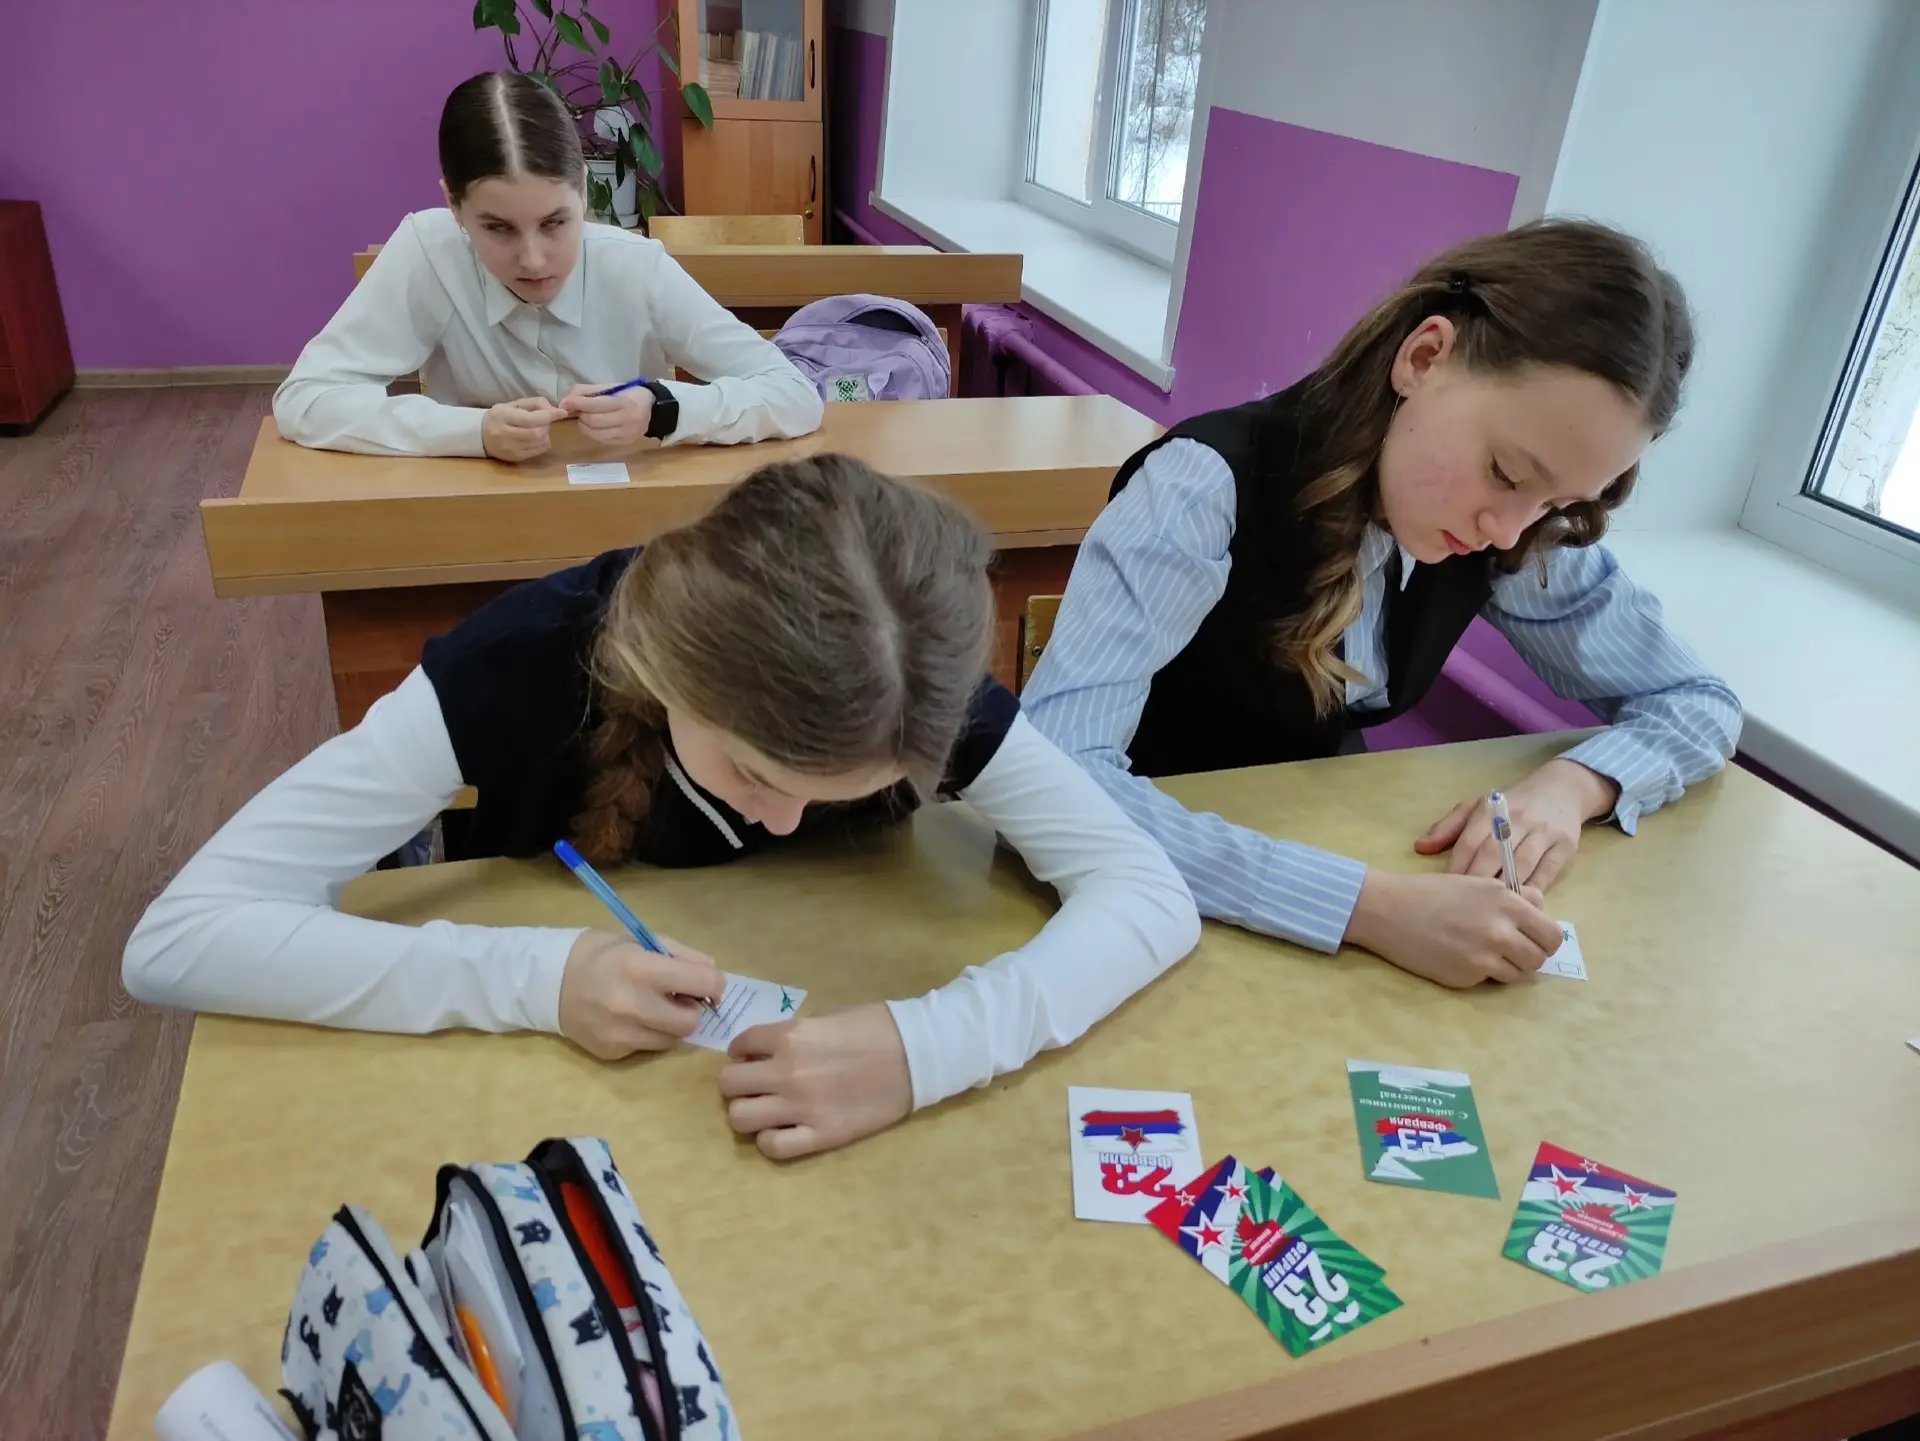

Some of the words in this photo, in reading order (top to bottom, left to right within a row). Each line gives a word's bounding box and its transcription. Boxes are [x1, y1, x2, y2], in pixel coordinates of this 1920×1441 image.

[1389, 1116, 1447, 1132] февраля
[1458, 1111, 1468, 1120] С
[1098, 1151, 1173, 1170] февраля
[1397, 1128, 1445, 1160] 23
[1099, 1163, 1175, 1197] 23
[1545, 1222, 1624, 1257] ФЕВРАЛЯ
[1262, 1240, 1308, 1289] ФЕВРАЛЯ
[1527, 1230, 1621, 1288] 23
[1272, 1249, 1349, 1326] 23
